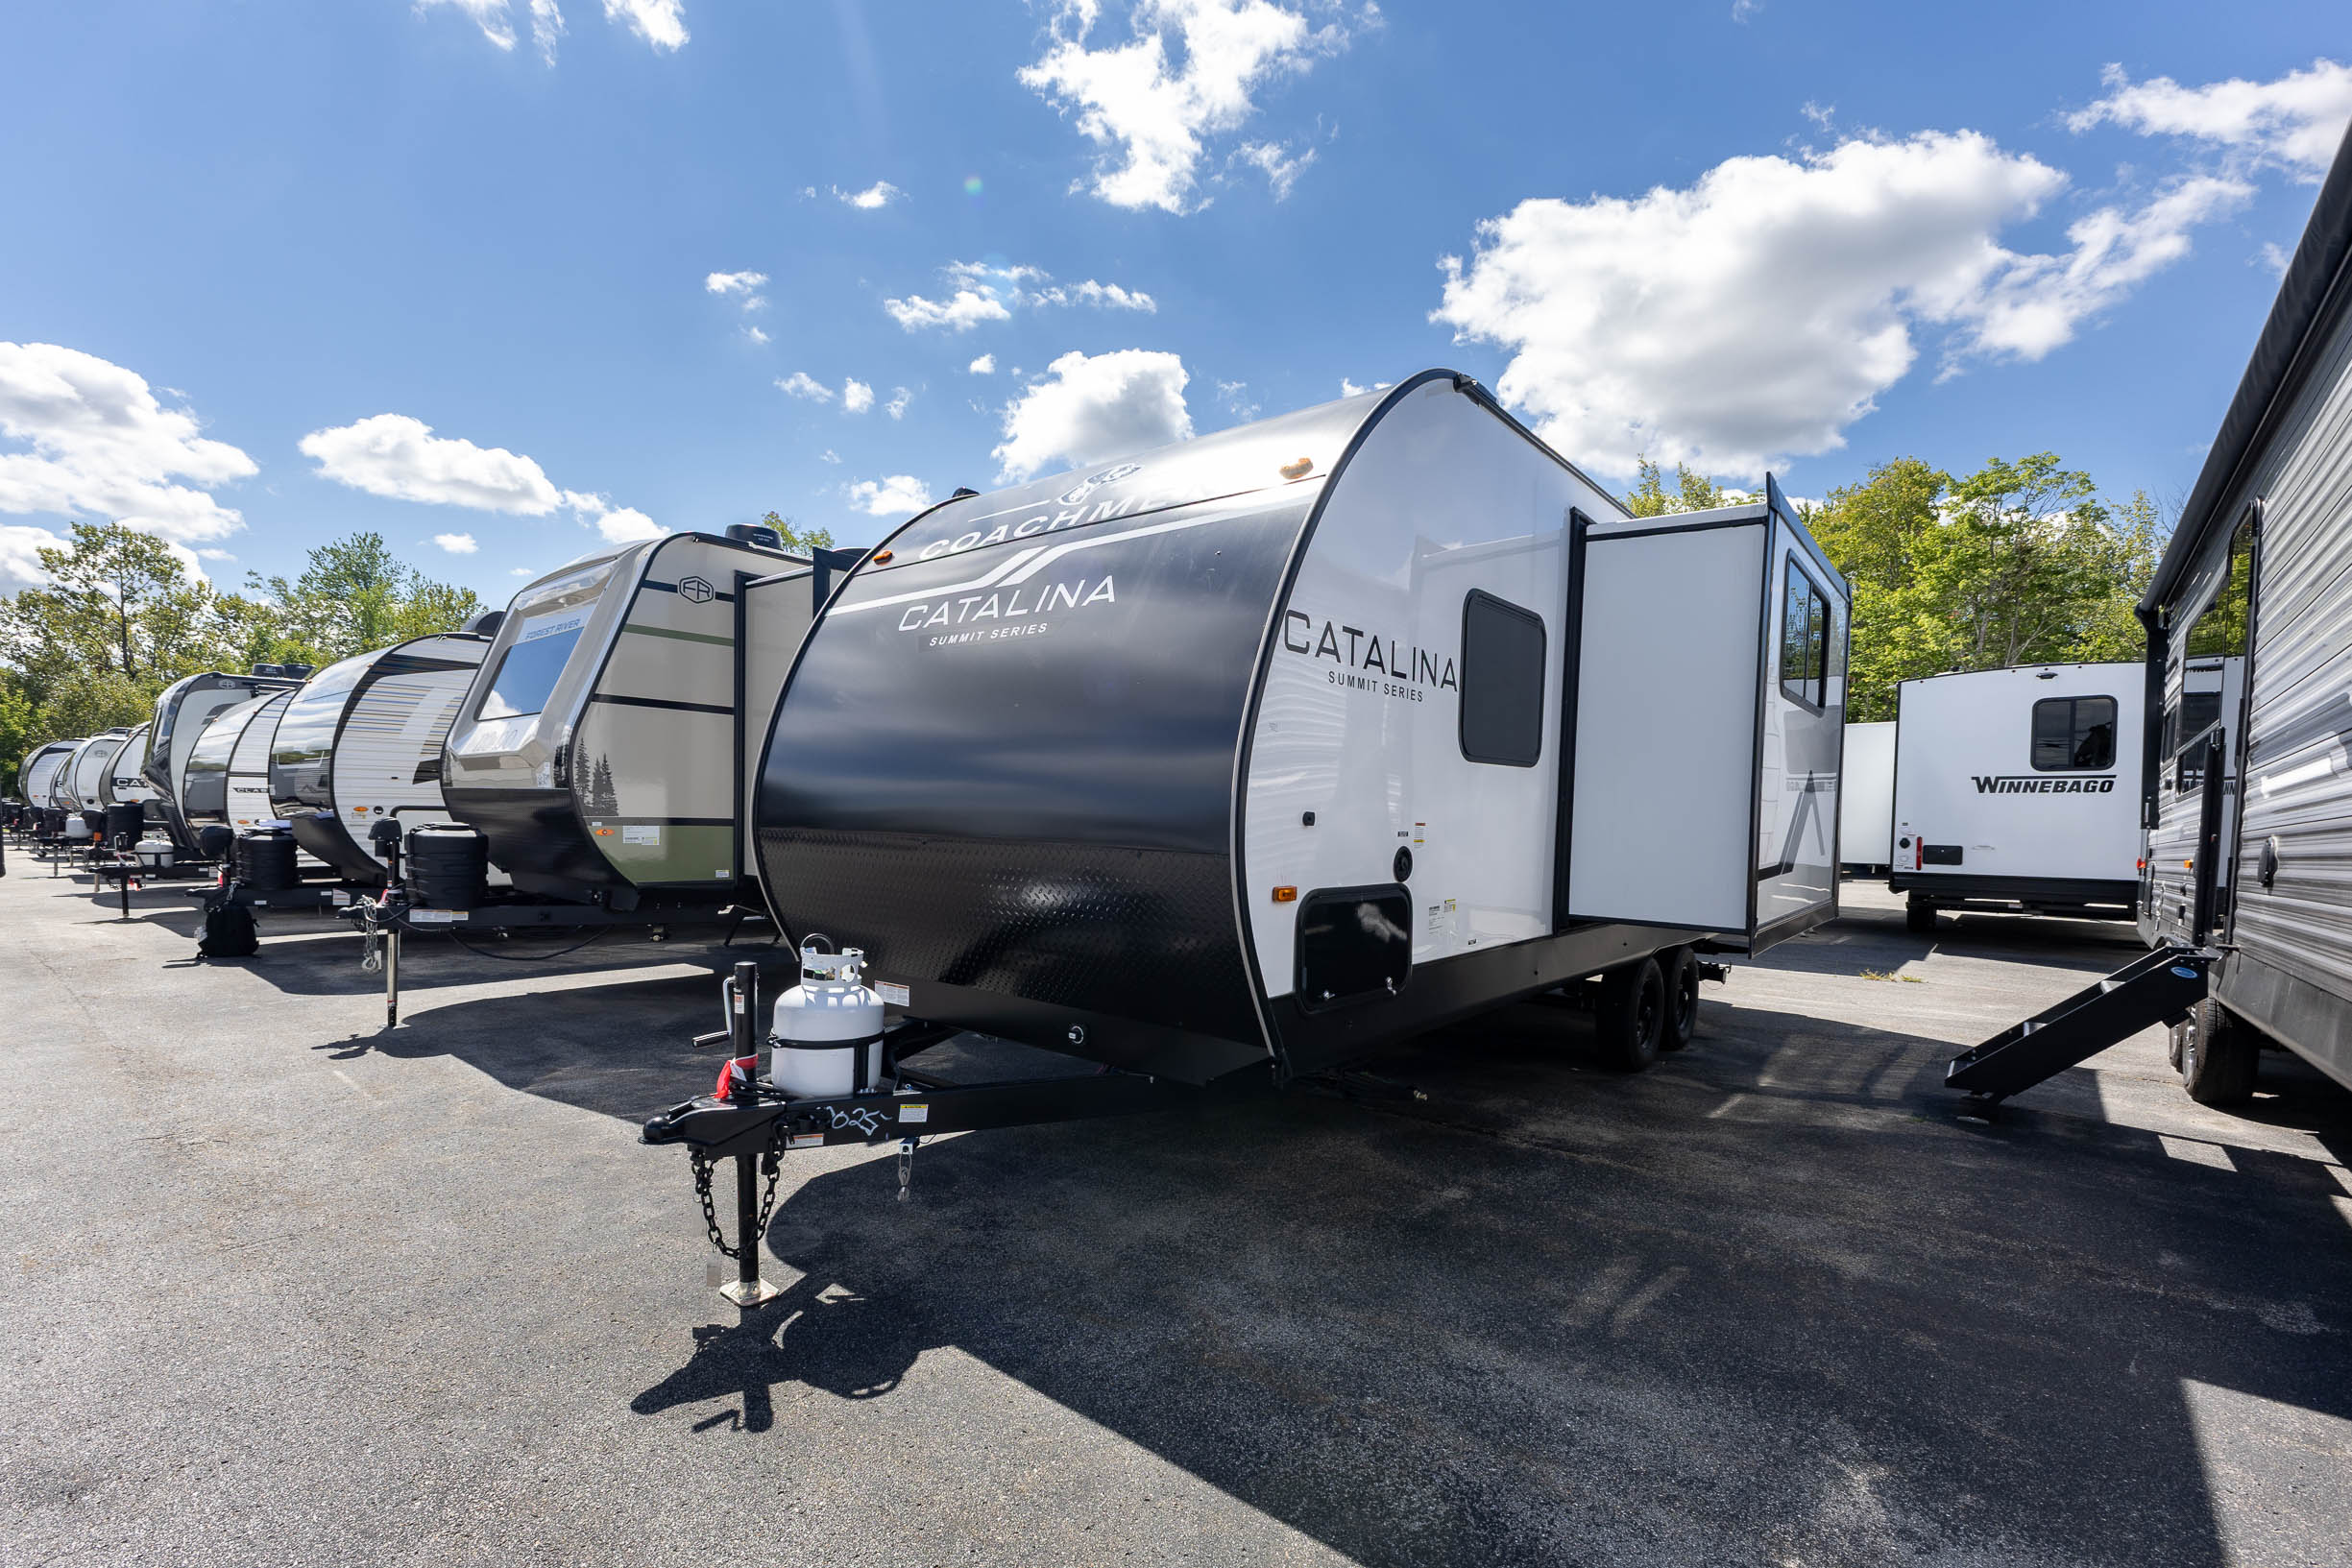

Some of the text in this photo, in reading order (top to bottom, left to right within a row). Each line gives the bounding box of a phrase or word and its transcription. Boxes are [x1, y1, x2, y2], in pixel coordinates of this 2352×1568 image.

[919, 493, 1179, 561] COACHME
[898, 575, 1116, 632] CATALINA
[929, 622, 1049, 647] SUMMIT SERIES
[1284, 609, 1458, 692] CATALINA
[1328, 670, 1423, 703] SUMMIT SERIES
[1971, 774, 2118, 794] WINNEBAGO
